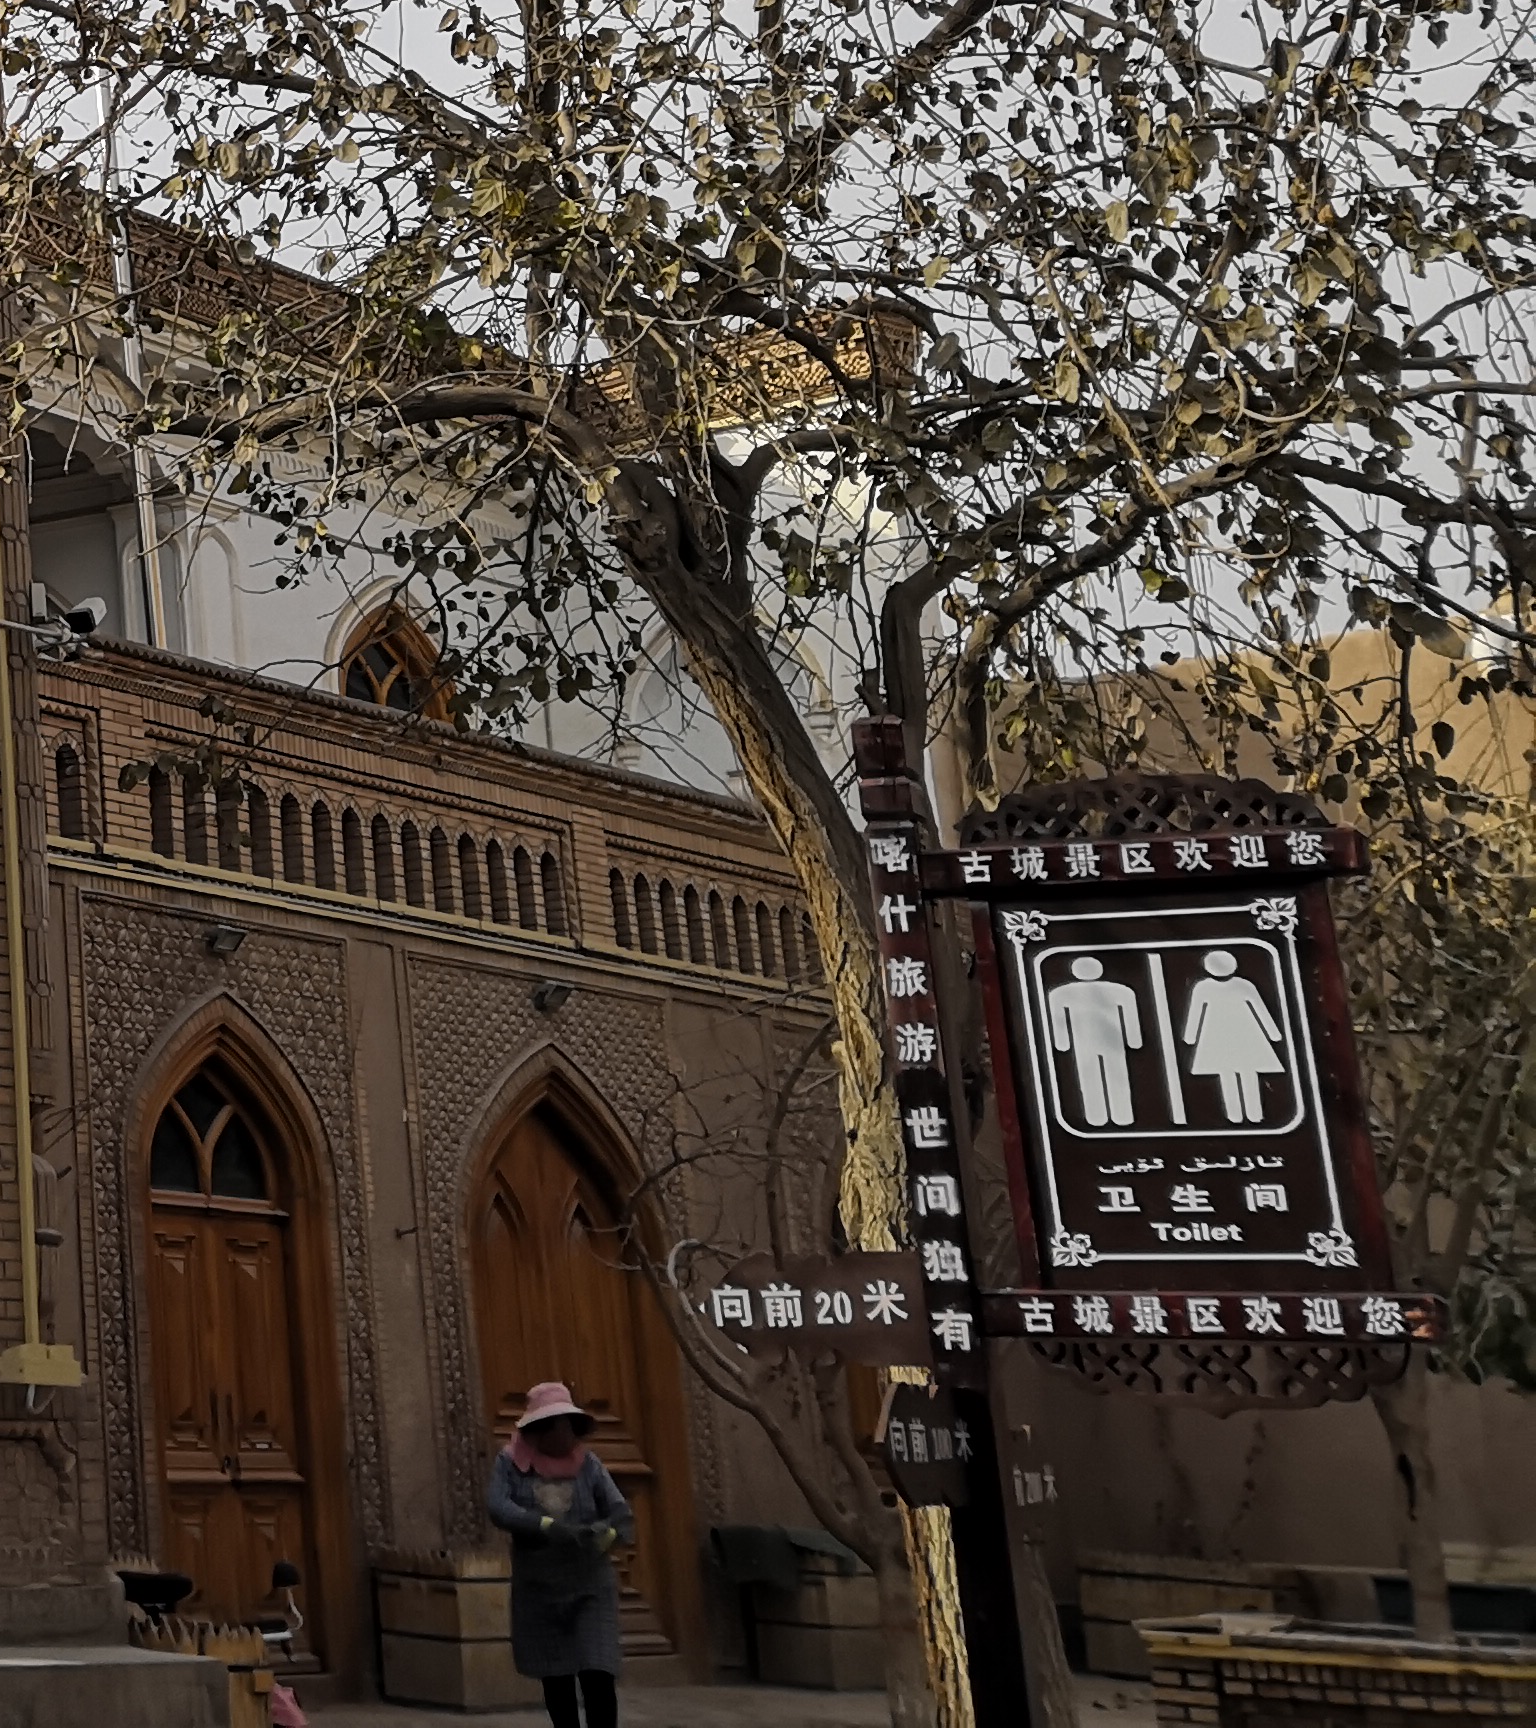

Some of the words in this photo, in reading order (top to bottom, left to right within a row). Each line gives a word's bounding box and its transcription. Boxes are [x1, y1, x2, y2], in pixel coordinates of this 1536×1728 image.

[959, 831, 1326, 884] 古城景区欢迎您
[1098, 1183, 1289, 1213] 卫生间
[1150, 1222, 1245, 1242] Toilet
[710, 1280, 908, 1327] 向前20米
[1019, 1295, 1406, 1336] 古城景区欢迎您
